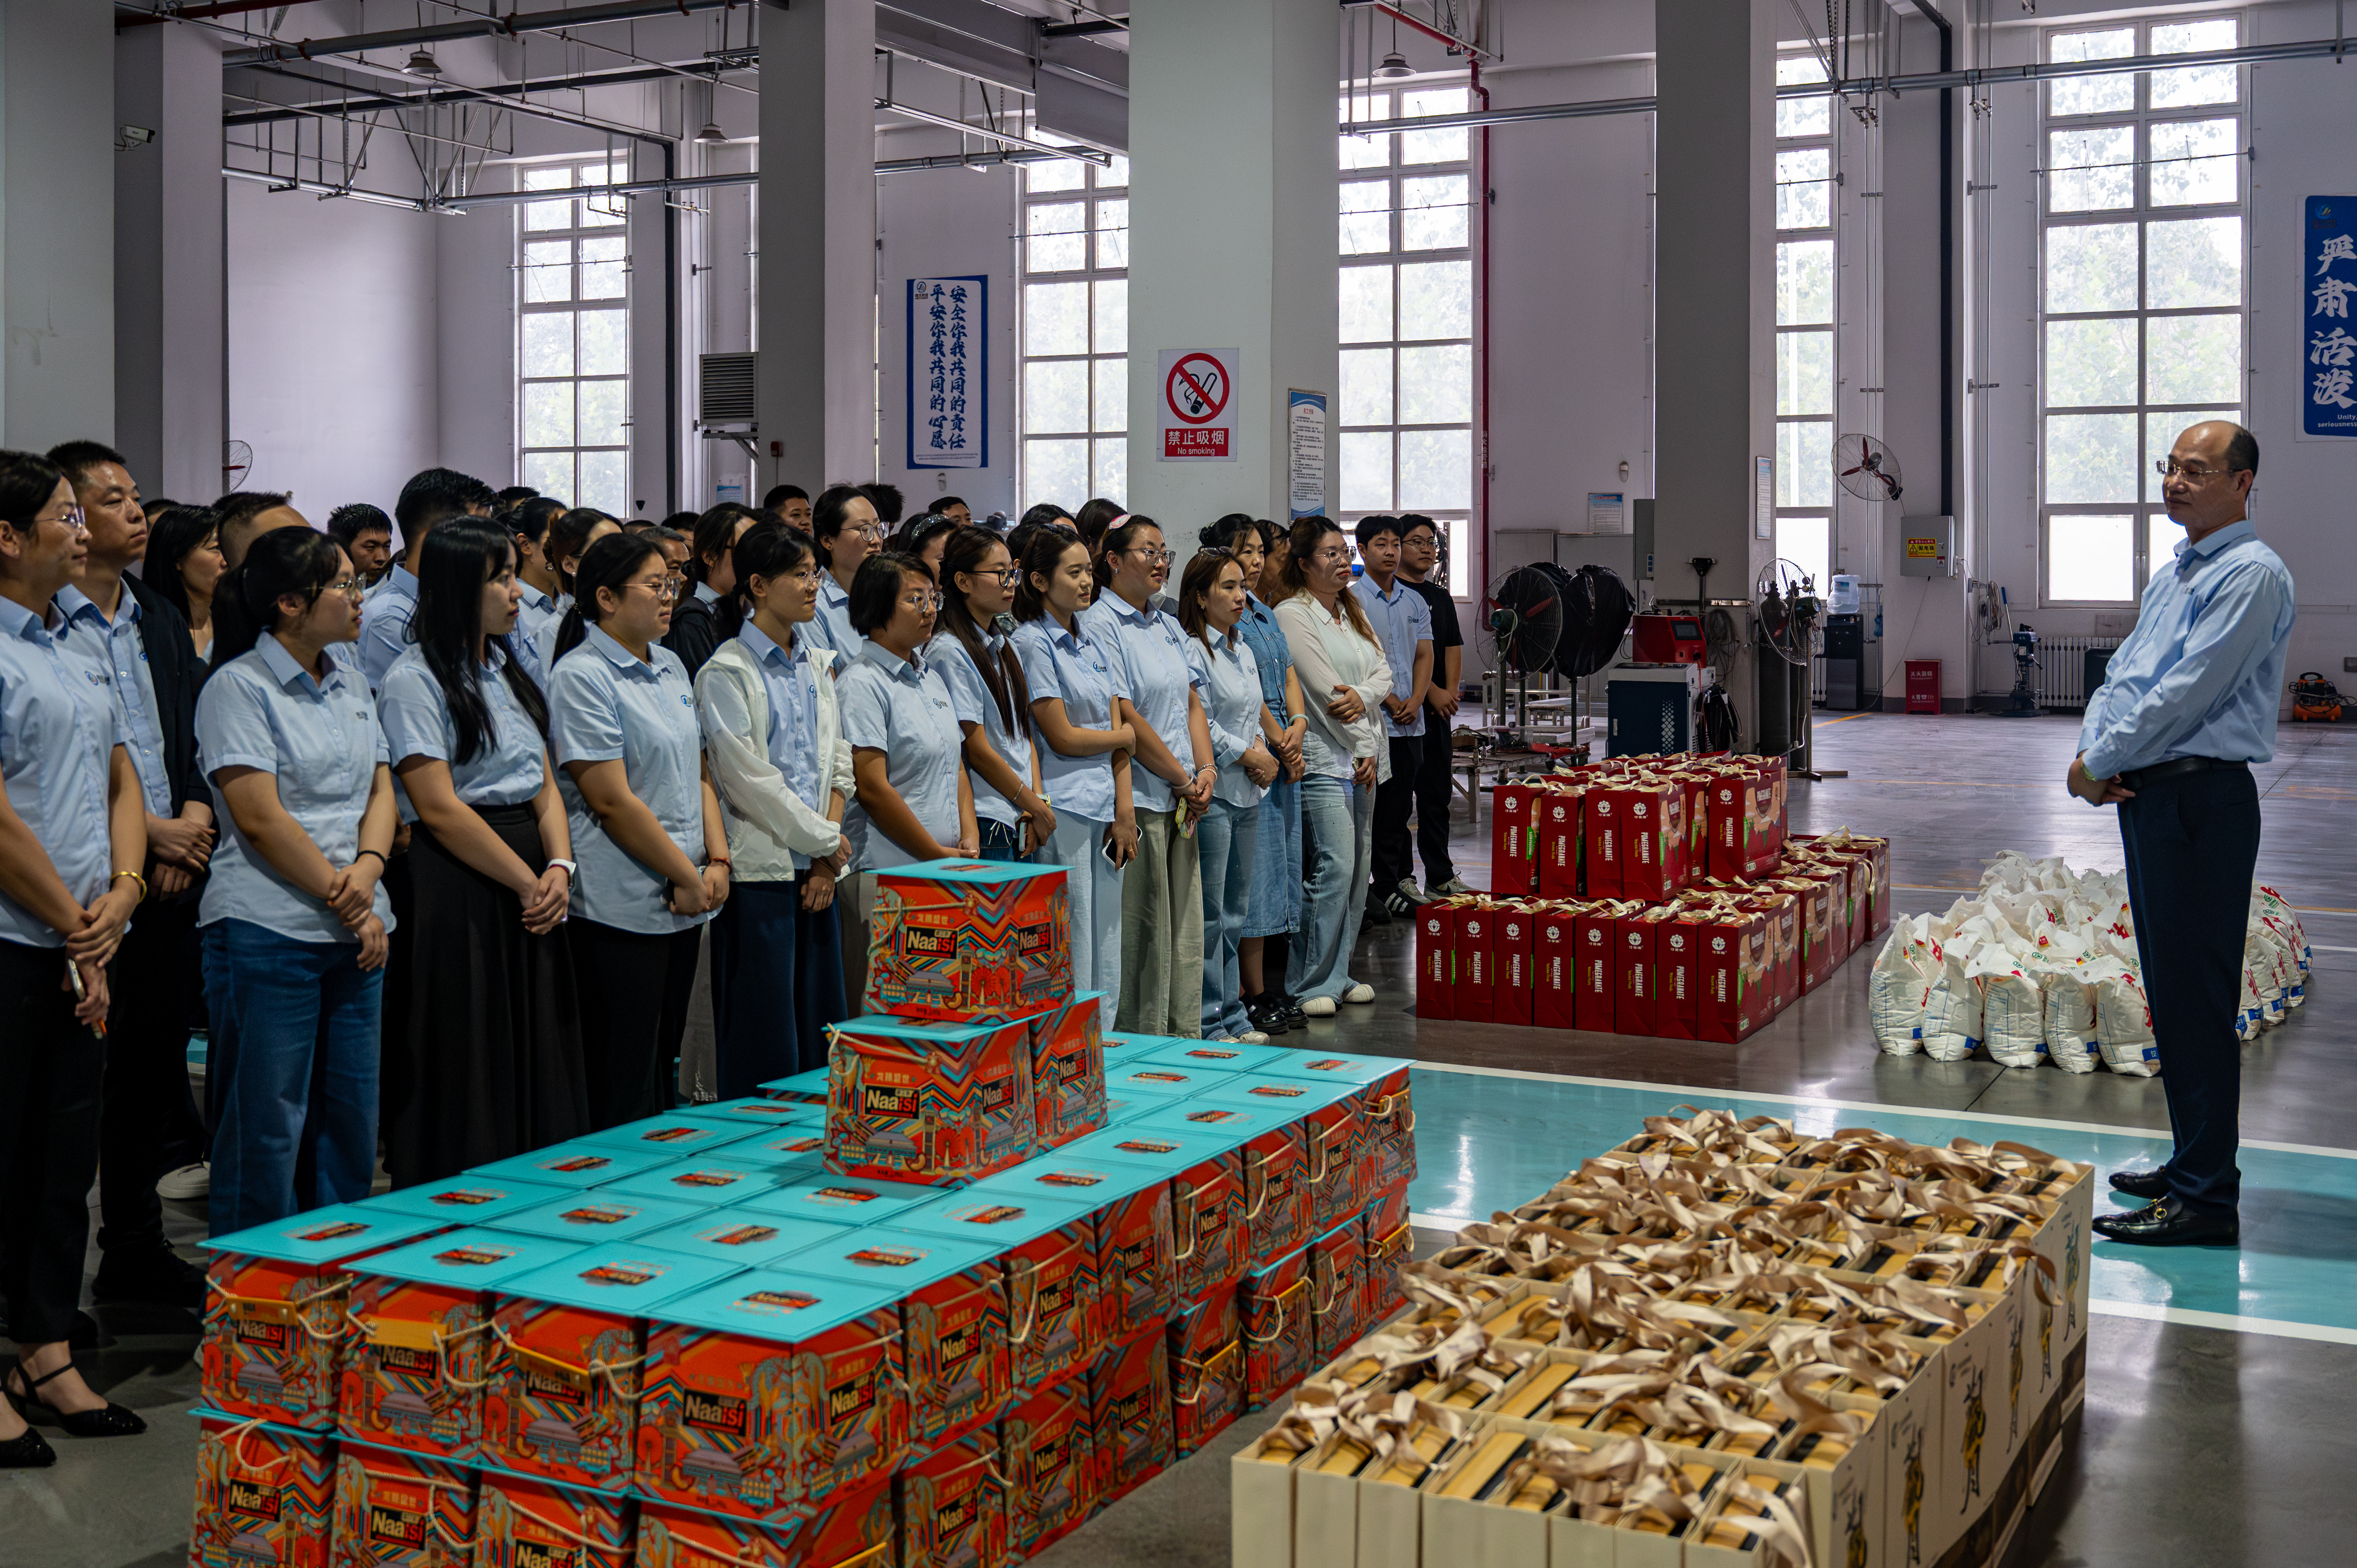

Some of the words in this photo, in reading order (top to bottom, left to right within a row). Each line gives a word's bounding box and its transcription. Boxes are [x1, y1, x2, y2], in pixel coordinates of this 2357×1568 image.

[929, 284, 948, 449] 平安你我共同的心愿
[948, 285, 968, 450] 安全你我共同的责任
[1168, 430, 1224, 445] 禁止吸烟
[1189, 447, 1215, 456] smoking
[1604, 830, 1613, 861] POMEGRANATE
[1641, 832, 1649, 864] POMEGRANATE
[907, 931, 956, 952] Naaisi
[1020, 926, 1049, 950] Naaisi
[1594, 960, 1603, 993] POMEGRANATE
[1676, 966, 1684, 999] POMEGRANATE
[1717, 969, 1726, 1003] POMEGRANATE
[1060, 1052, 1085, 1079] Naaisi
[867, 1089, 918, 1112] Naaisi
[984, 1078, 1012, 1107] Naaisi
[1040, 1280, 1072, 1315] Naaisi
[942, 1325, 979, 1363] Naaisi
[685, 1395, 745, 1428] Naaisi
[831, 1376, 873, 1418] Naaisi
[231, 1484, 280, 1515] Naaisi
[940, 1493, 975, 1535] Naaisi
[372, 1510, 425, 1542] Naaisi
